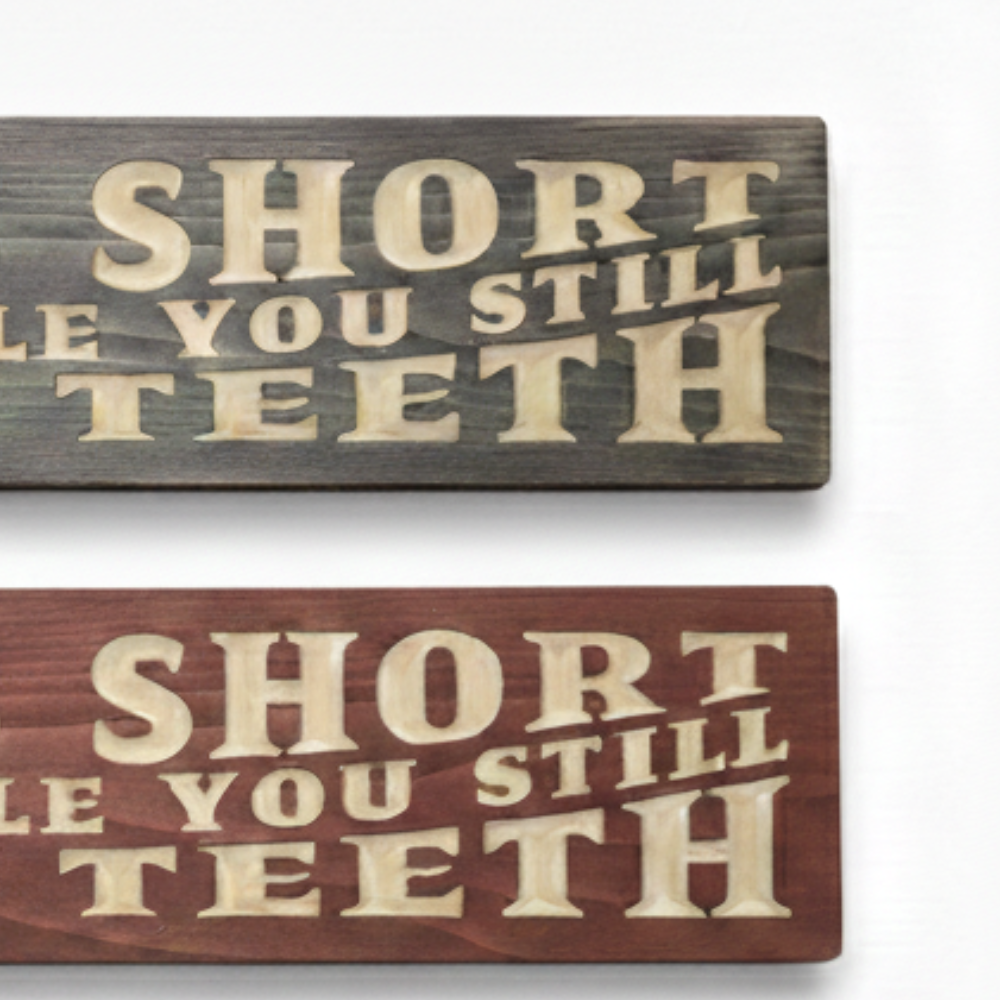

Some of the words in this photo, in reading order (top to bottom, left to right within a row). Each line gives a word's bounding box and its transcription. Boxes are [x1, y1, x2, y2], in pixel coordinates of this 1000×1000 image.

[91, 158, 781, 292] SHORT
[158, 287, 413, 359] YOU
[469, 235, 783, 335] STILL
[56, 303, 784, 444] TEETH
[89, 629, 789, 766] SHORT
[158, 759, 417, 833] YOU
[473, 707, 789, 808] STILL
[59, 776, 792, 919] TEETH
